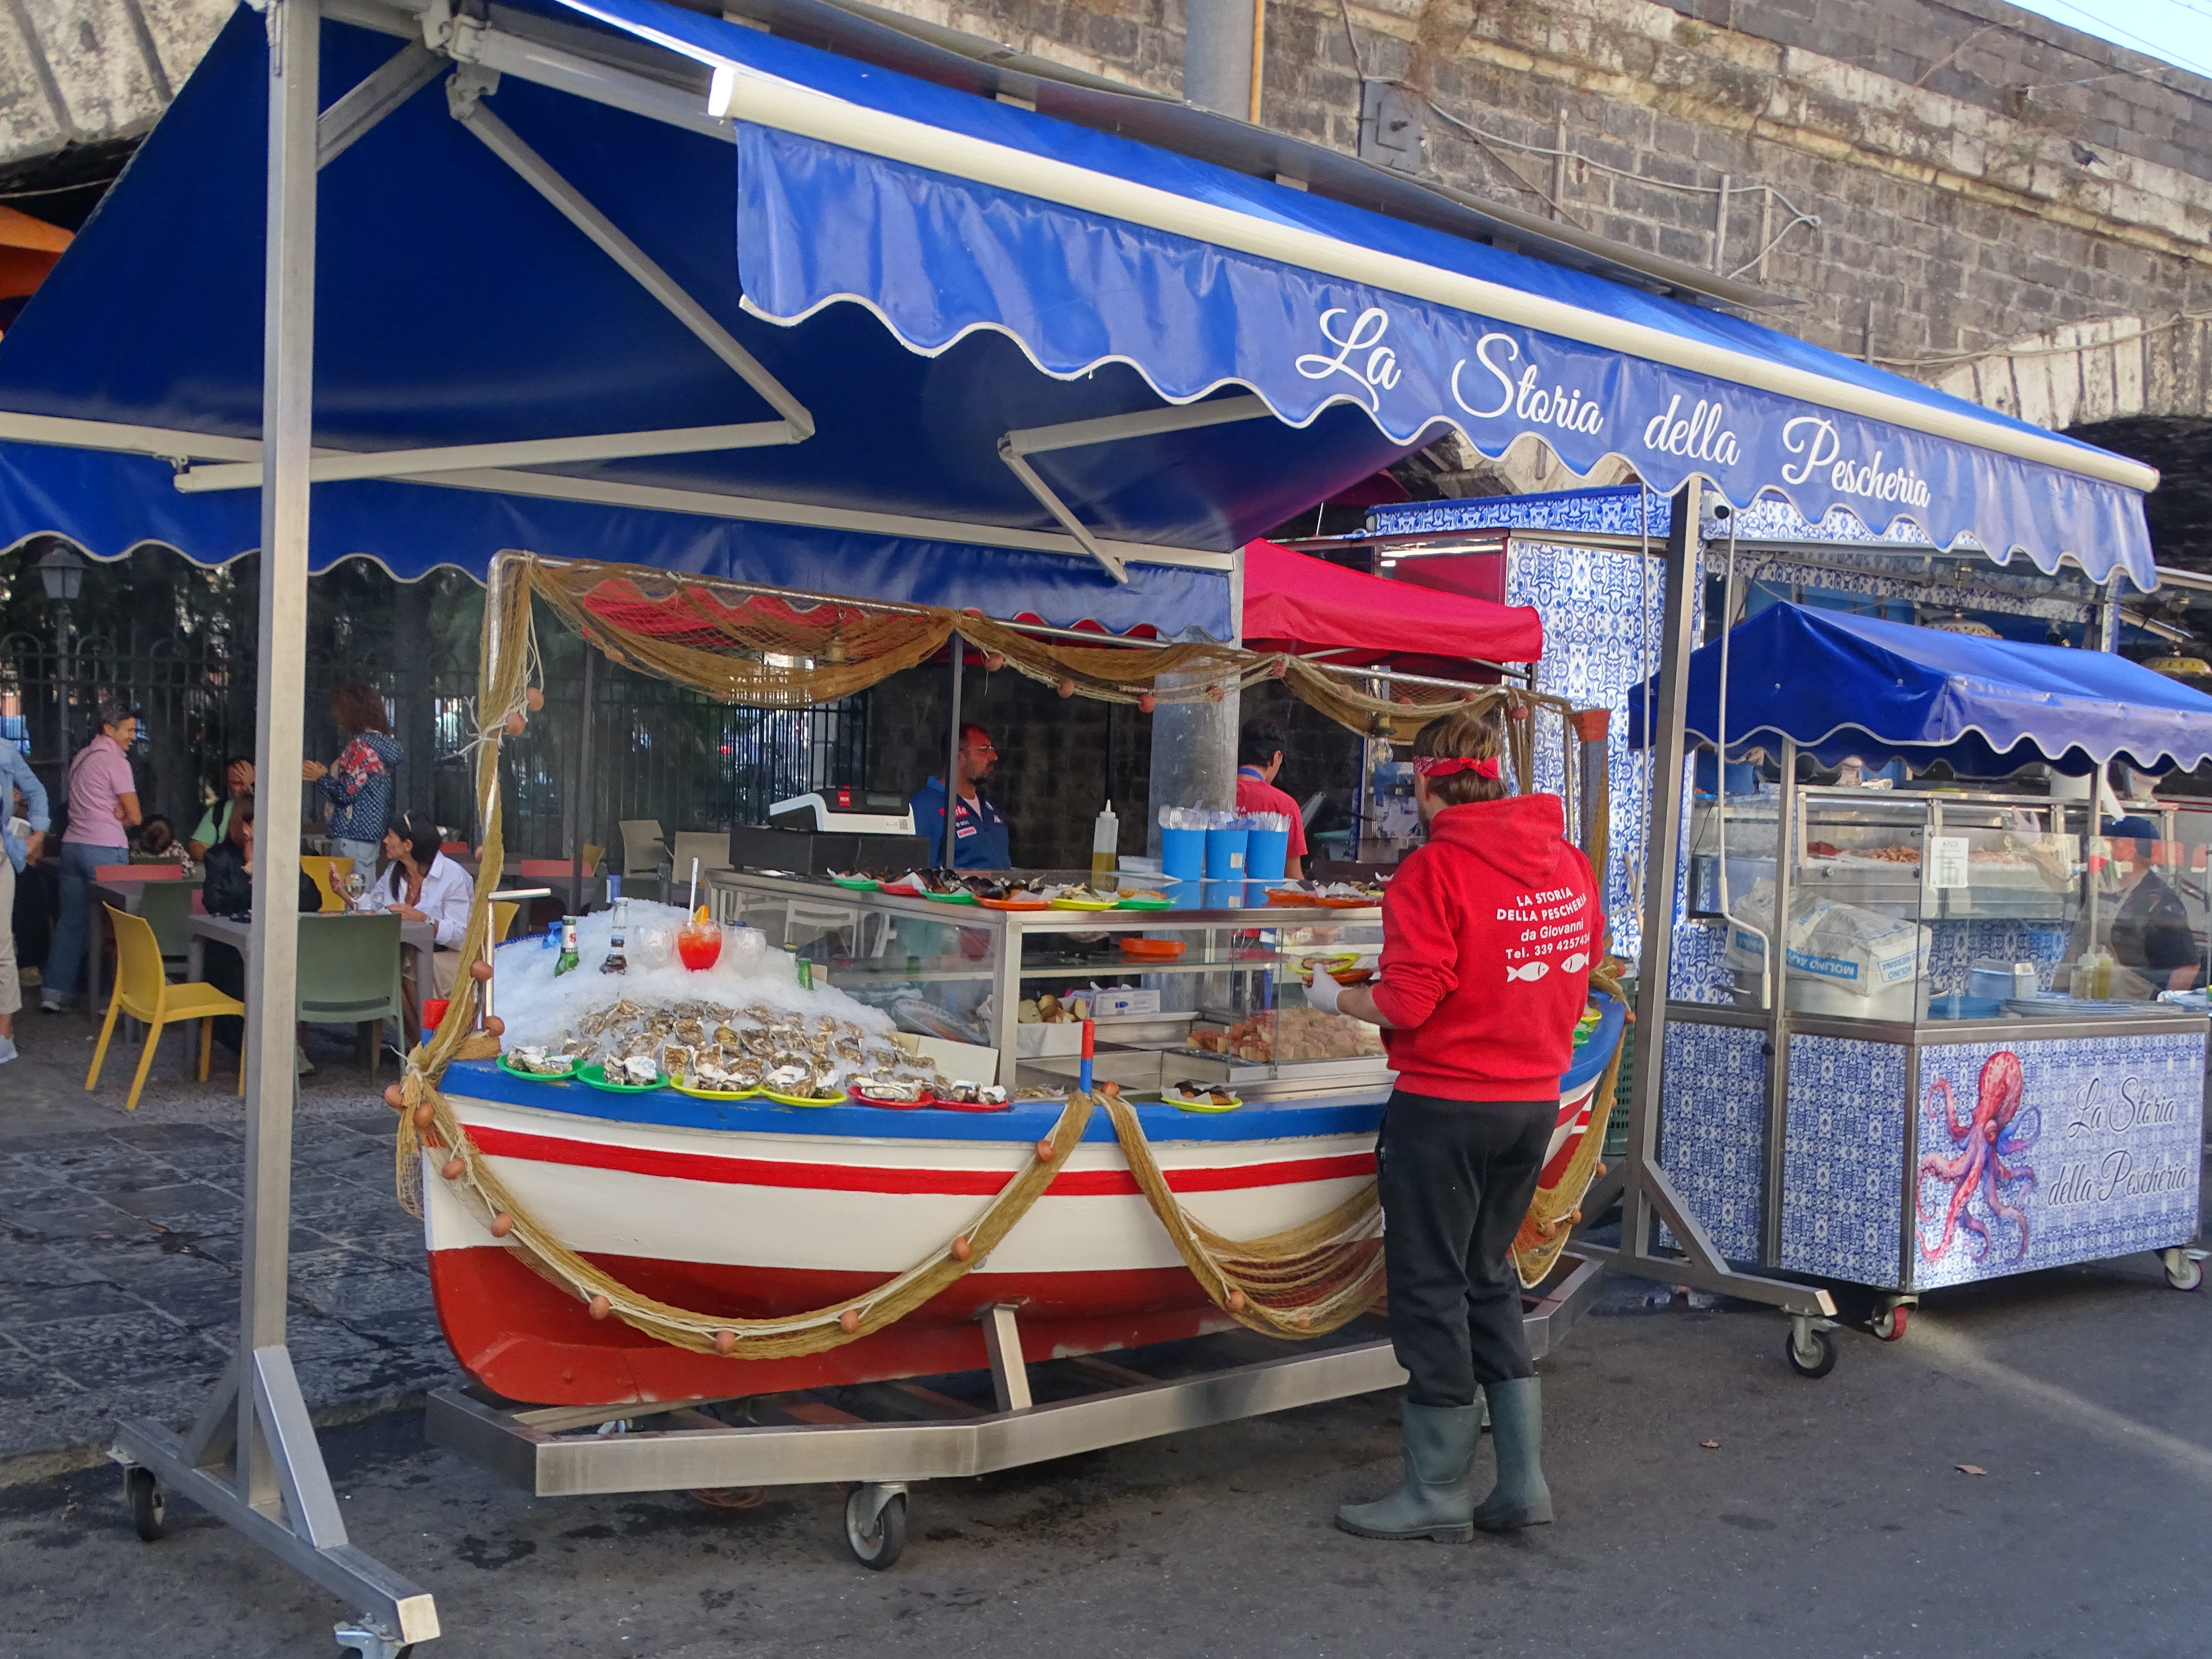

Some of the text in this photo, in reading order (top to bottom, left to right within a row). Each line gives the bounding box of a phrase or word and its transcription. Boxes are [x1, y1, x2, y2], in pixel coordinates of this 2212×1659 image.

[1295, 307, 1931, 509] La Storia della Pescheria
[1496, 893, 1587, 921] DELLA PESCHERIA
[1516, 887, 1573, 907] LA STORIA
[1521, 917, 1583, 942] da Giovanni
[1505, 946, 1529, 960] Tel.
[1534, 943, 1553, 956] 339
[1809, 960, 1854, 975] MOLINO
[2067, 1077, 2175, 1145] La Storia
[2048, 1148, 2187, 1206] della Pescheria
